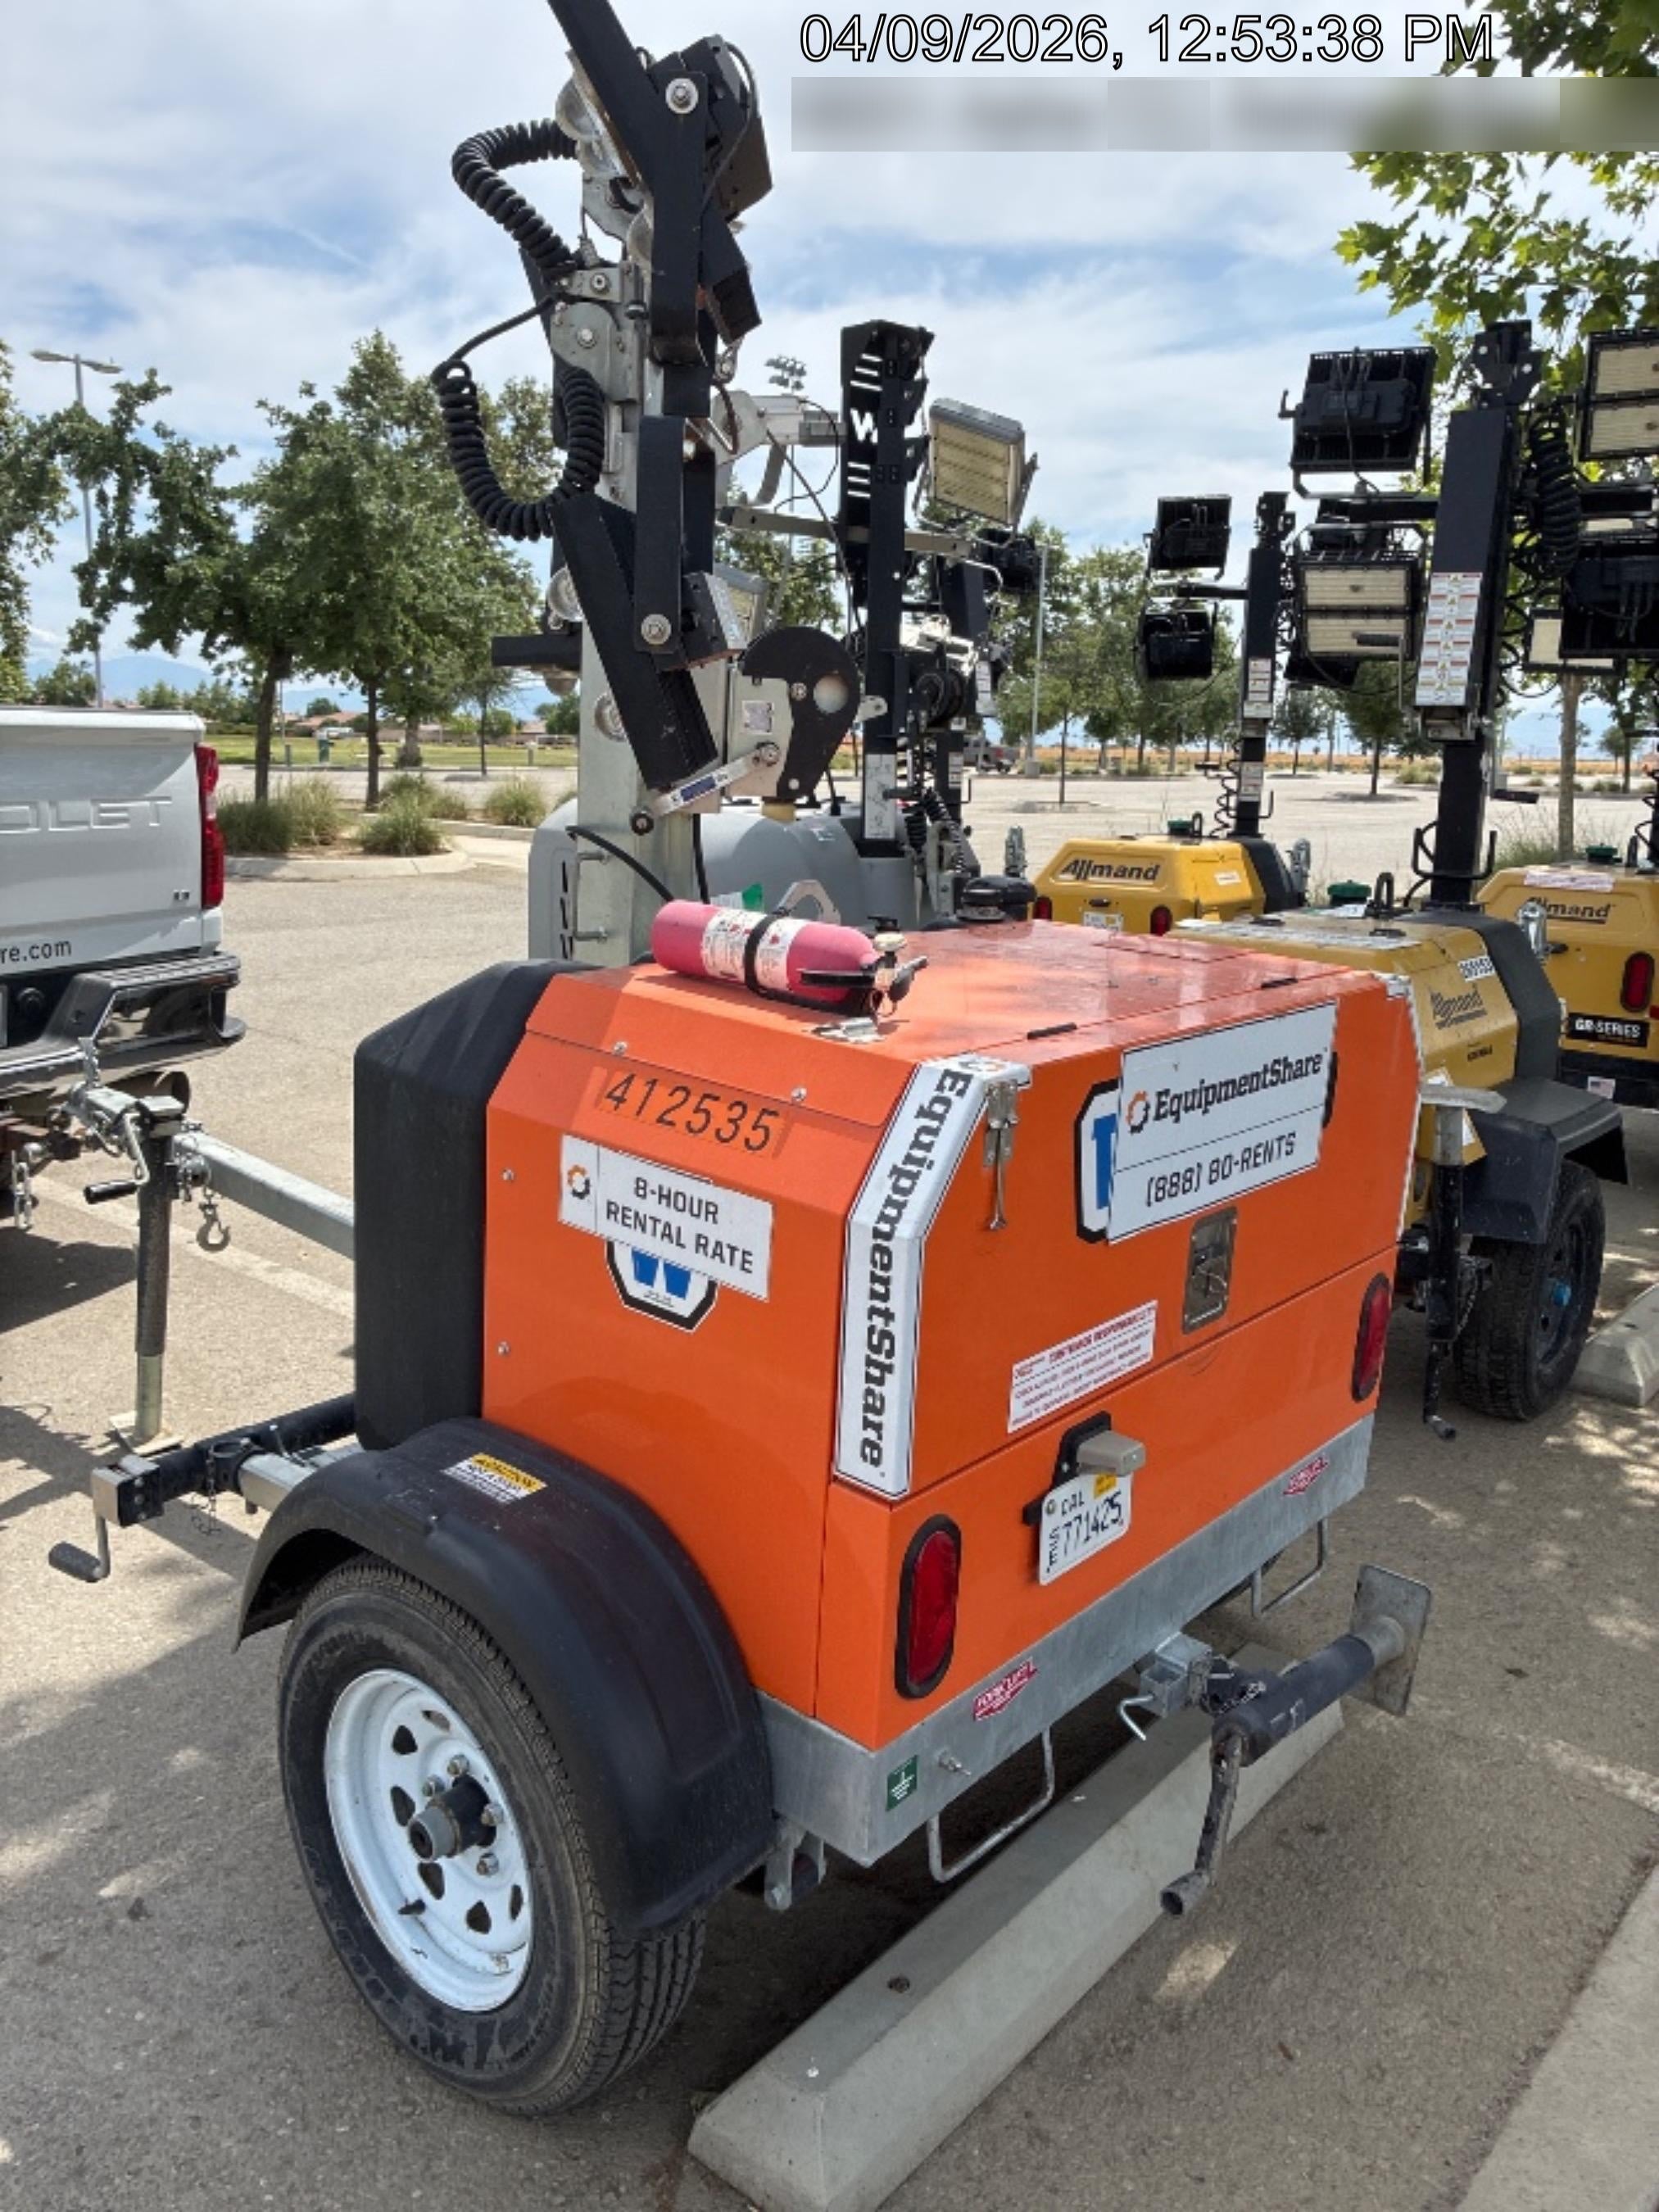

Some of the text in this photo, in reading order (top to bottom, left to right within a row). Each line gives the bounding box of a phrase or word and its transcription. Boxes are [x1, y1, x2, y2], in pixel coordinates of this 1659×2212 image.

[1062, 859, 1160, 881] Allmand
[0, 941, 72, 964] re.com
[605, 1073, 780, 1152] 412535
[1153, 1052, 1323, 1123] EquipmentShare
[633, 1176, 718, 1225] 8-HOUR
[1145, 1162, 1202, 1207] (888)
[605, 1199, 754, 1274] RENTAL RATE
[860, 1068, 972, 1469] EquipmentShare
[1062, 1489, 1122, 1557] 771425
